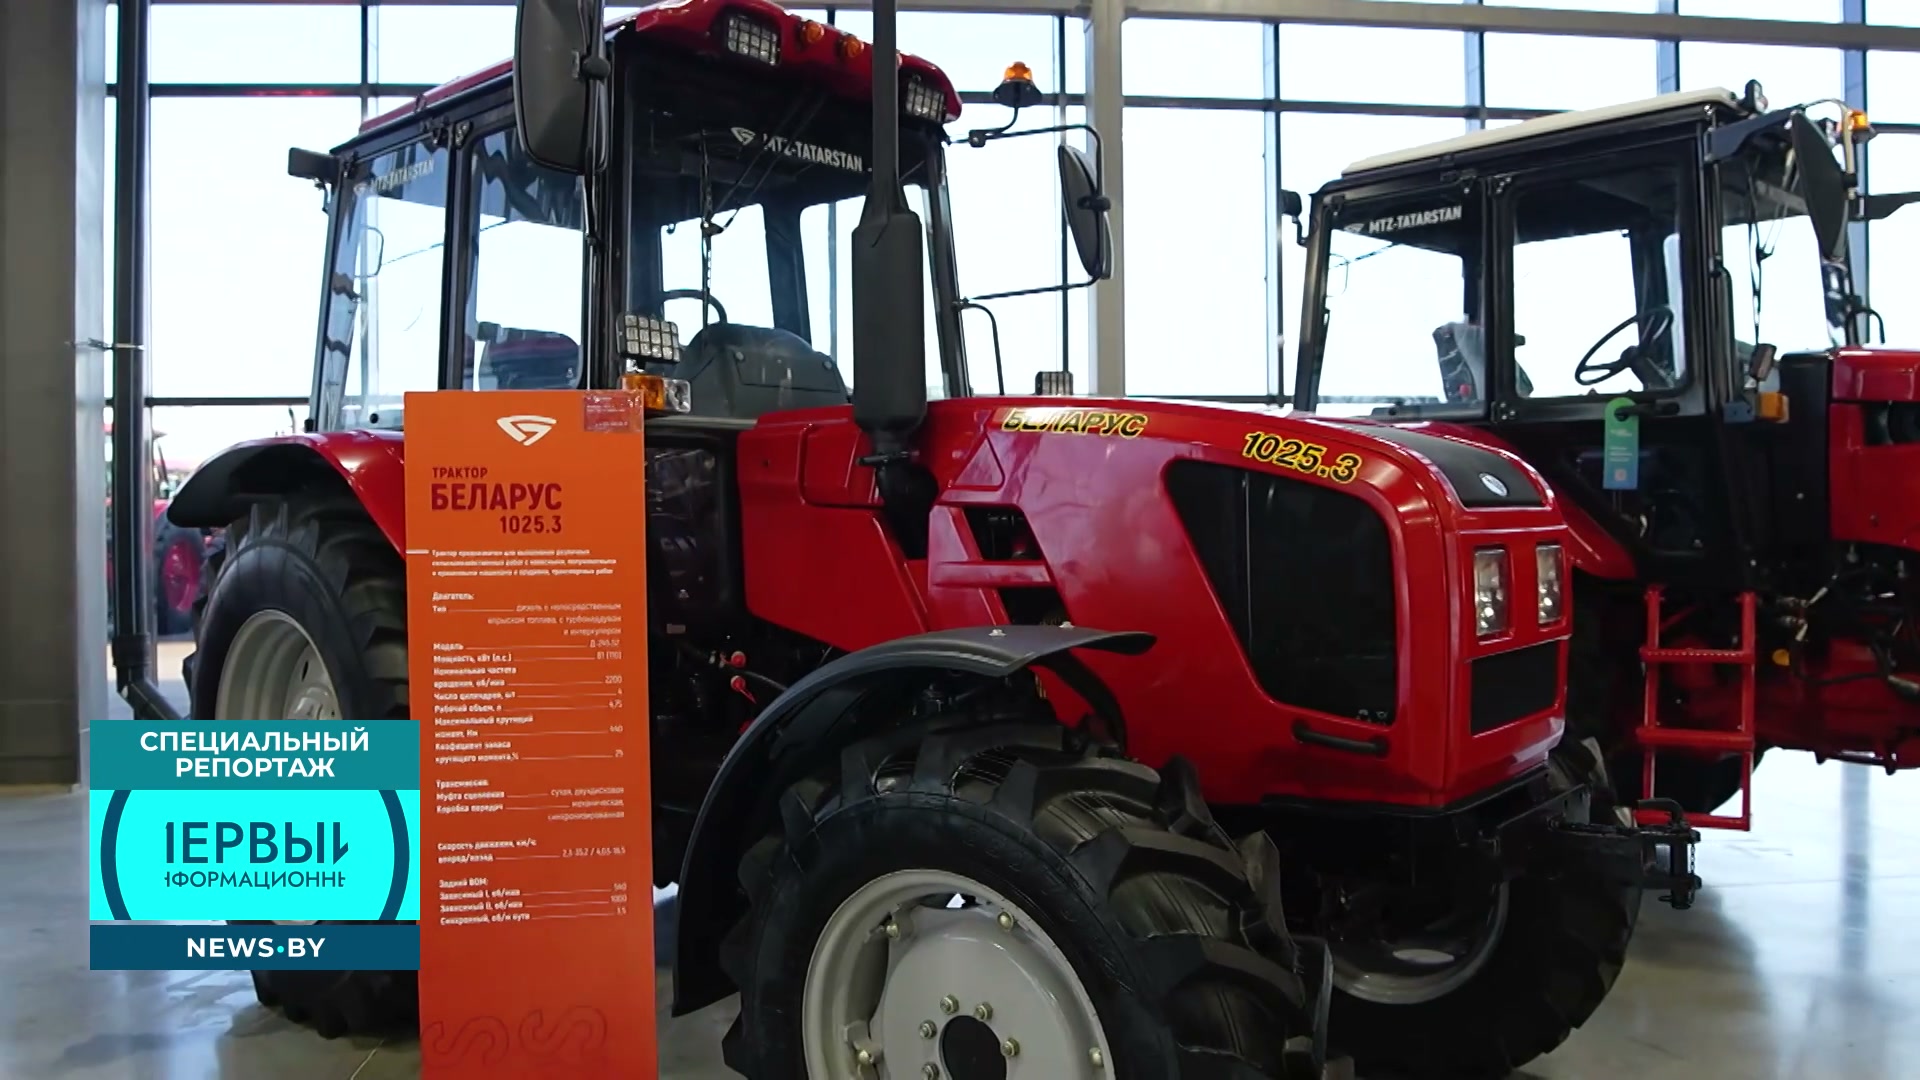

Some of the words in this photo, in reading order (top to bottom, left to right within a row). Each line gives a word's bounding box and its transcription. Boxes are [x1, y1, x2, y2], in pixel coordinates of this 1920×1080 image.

[1369, 205, 1462, 233] MTZ-TATARSTAN
[1241, 431, 1362, 483] 1025.3
[432, 467, 488, 479] ТРАКТОР
[431, 483, 562, 511] БЕЛАРУС
[500, 515, 562, 534] 1025.3
